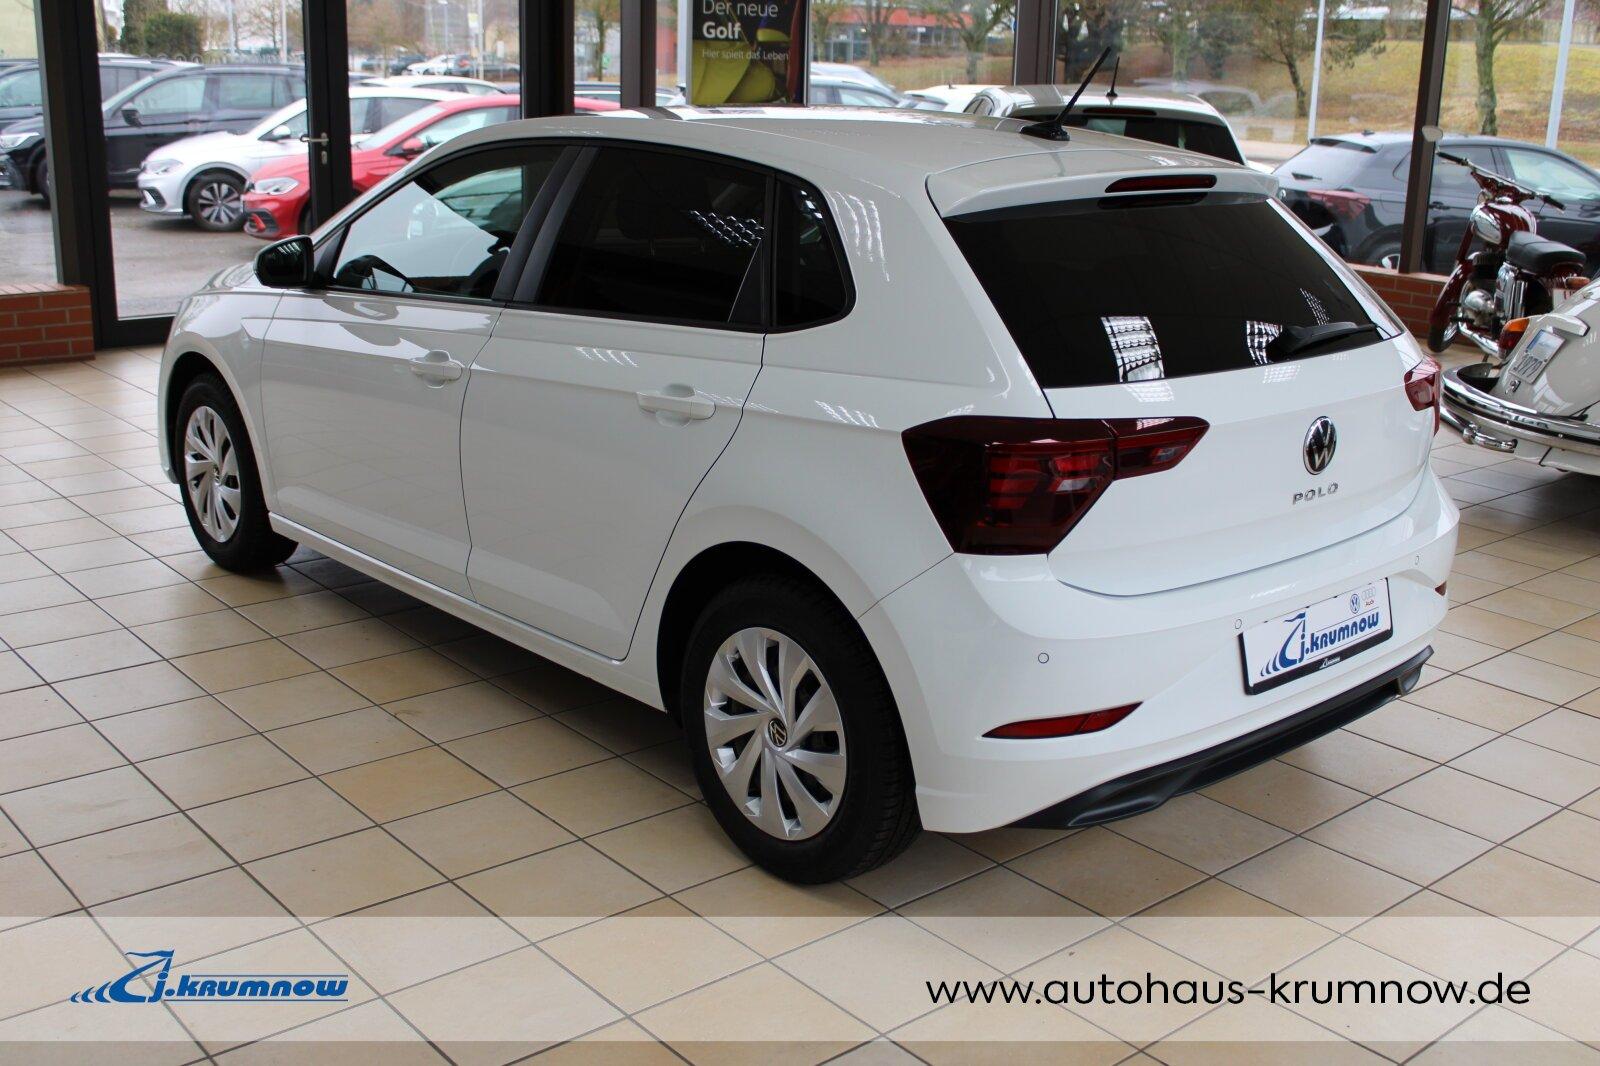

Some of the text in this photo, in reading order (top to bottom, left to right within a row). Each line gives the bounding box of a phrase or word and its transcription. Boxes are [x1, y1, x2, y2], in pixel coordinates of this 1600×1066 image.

[702, 0, 779, 18] Der neue
[702, 21, 742, 40] Golf
[702, 49, 719, 59] Hier
[721, 49, 744, 61] spielt
[746, 49, 761, 60] das
[1292, 482, 1339, 505] POLO
